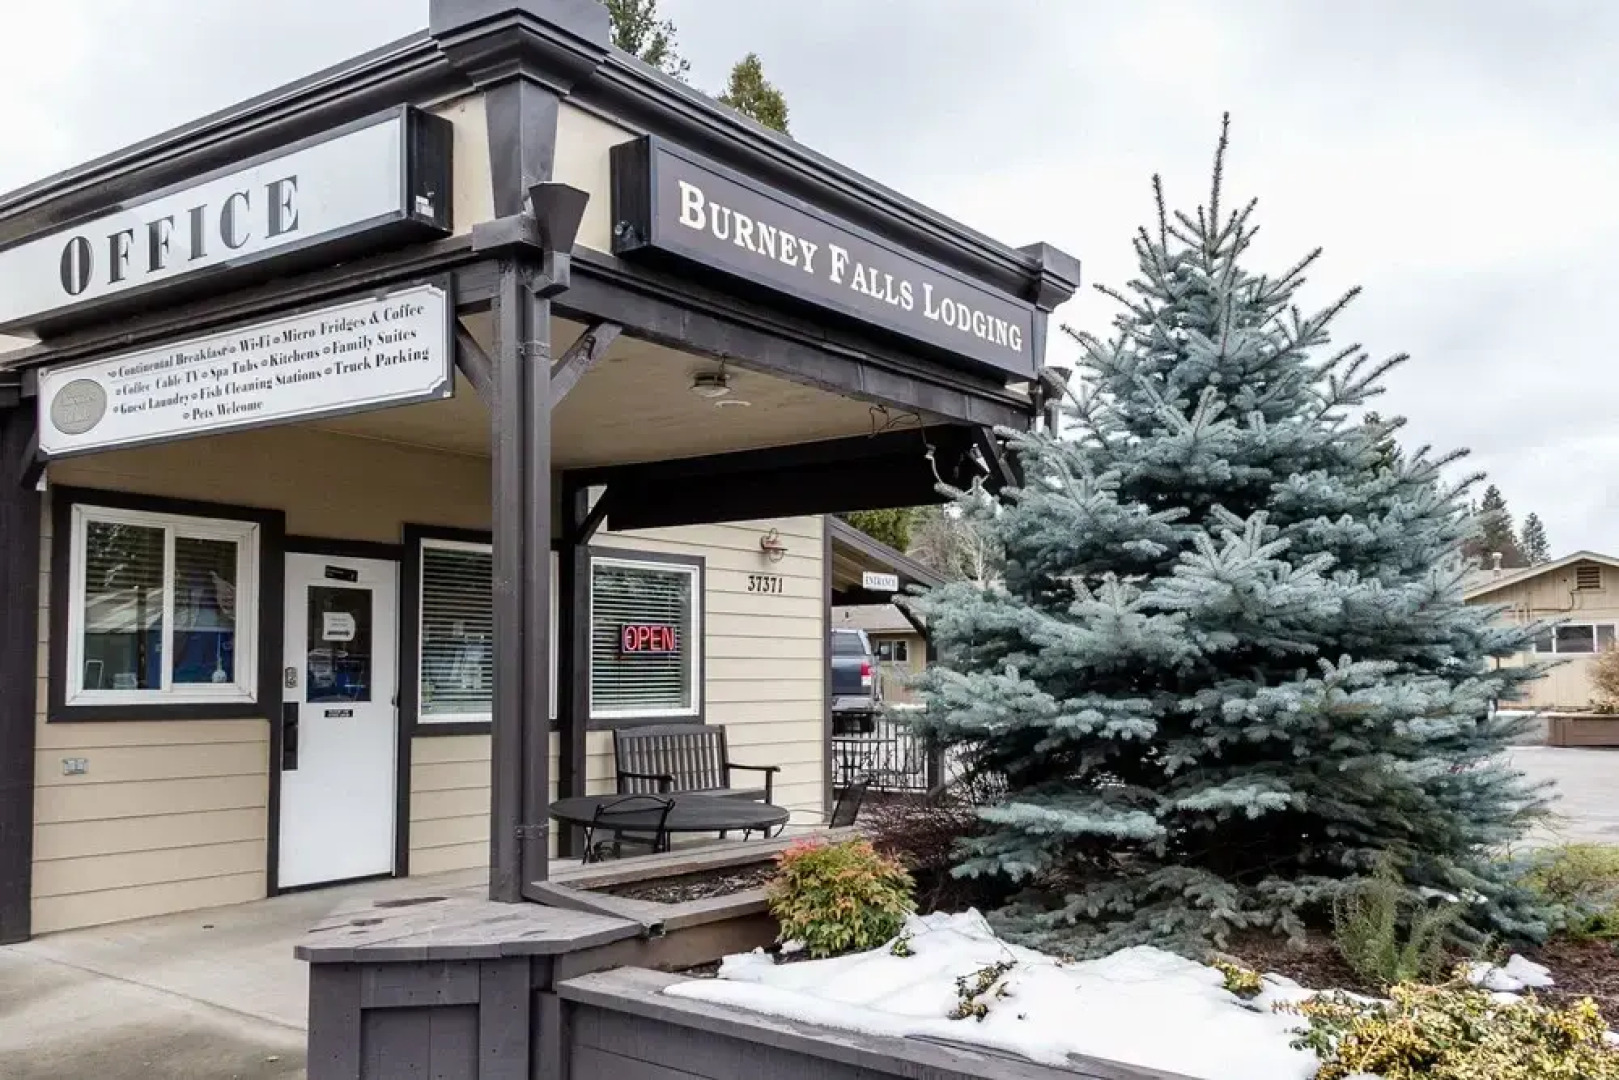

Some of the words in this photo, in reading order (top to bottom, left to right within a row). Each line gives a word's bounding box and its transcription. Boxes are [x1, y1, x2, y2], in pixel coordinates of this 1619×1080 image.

[60, 174, 299, 296] OFFICE
[678, 180, 818, 275] BURNEY
[829, 244, 914, 311] FALLS
[923, 282, 1023, 352] LODGING
[119, 354, 174, 377] Continental
[176, 346, 228, 365] Breakfast
[240, 335, 270, 351] Wi-Fi
[282, 328, 316, 343] Micro
[320, 317, 366, 336] Fridges
[369, 310, 380, 325] &
[383, 303, 425, 322] Coffee
[156, 376, 182, 389] Cable
[186, 370, 199, 383] TV
[210, 368, 229, 382] Spa
[232, 359, 258, 374] Tubs
[269, 347, 320, 367] Kitchens
[332, 333, 373, 354] Family
[377, 328, 417, 346] Suites
[121, 401, 146, 414] Guest
[148, 392, 189, 409] Laundry
[200, 385, 222, 400] Fish
[225, 377, 273, 395] Cleaning
[276, 368, 322, 386] Stations
[334, 355, 372, 375] Truck
[375, 346, 430, 368] Parking
[192, 407, 213, 420] Pets
[217, 400, 263, 416] Welcome
[747, 574, 783, 594] 37371
[624, 625, 675, 651] OPEN
